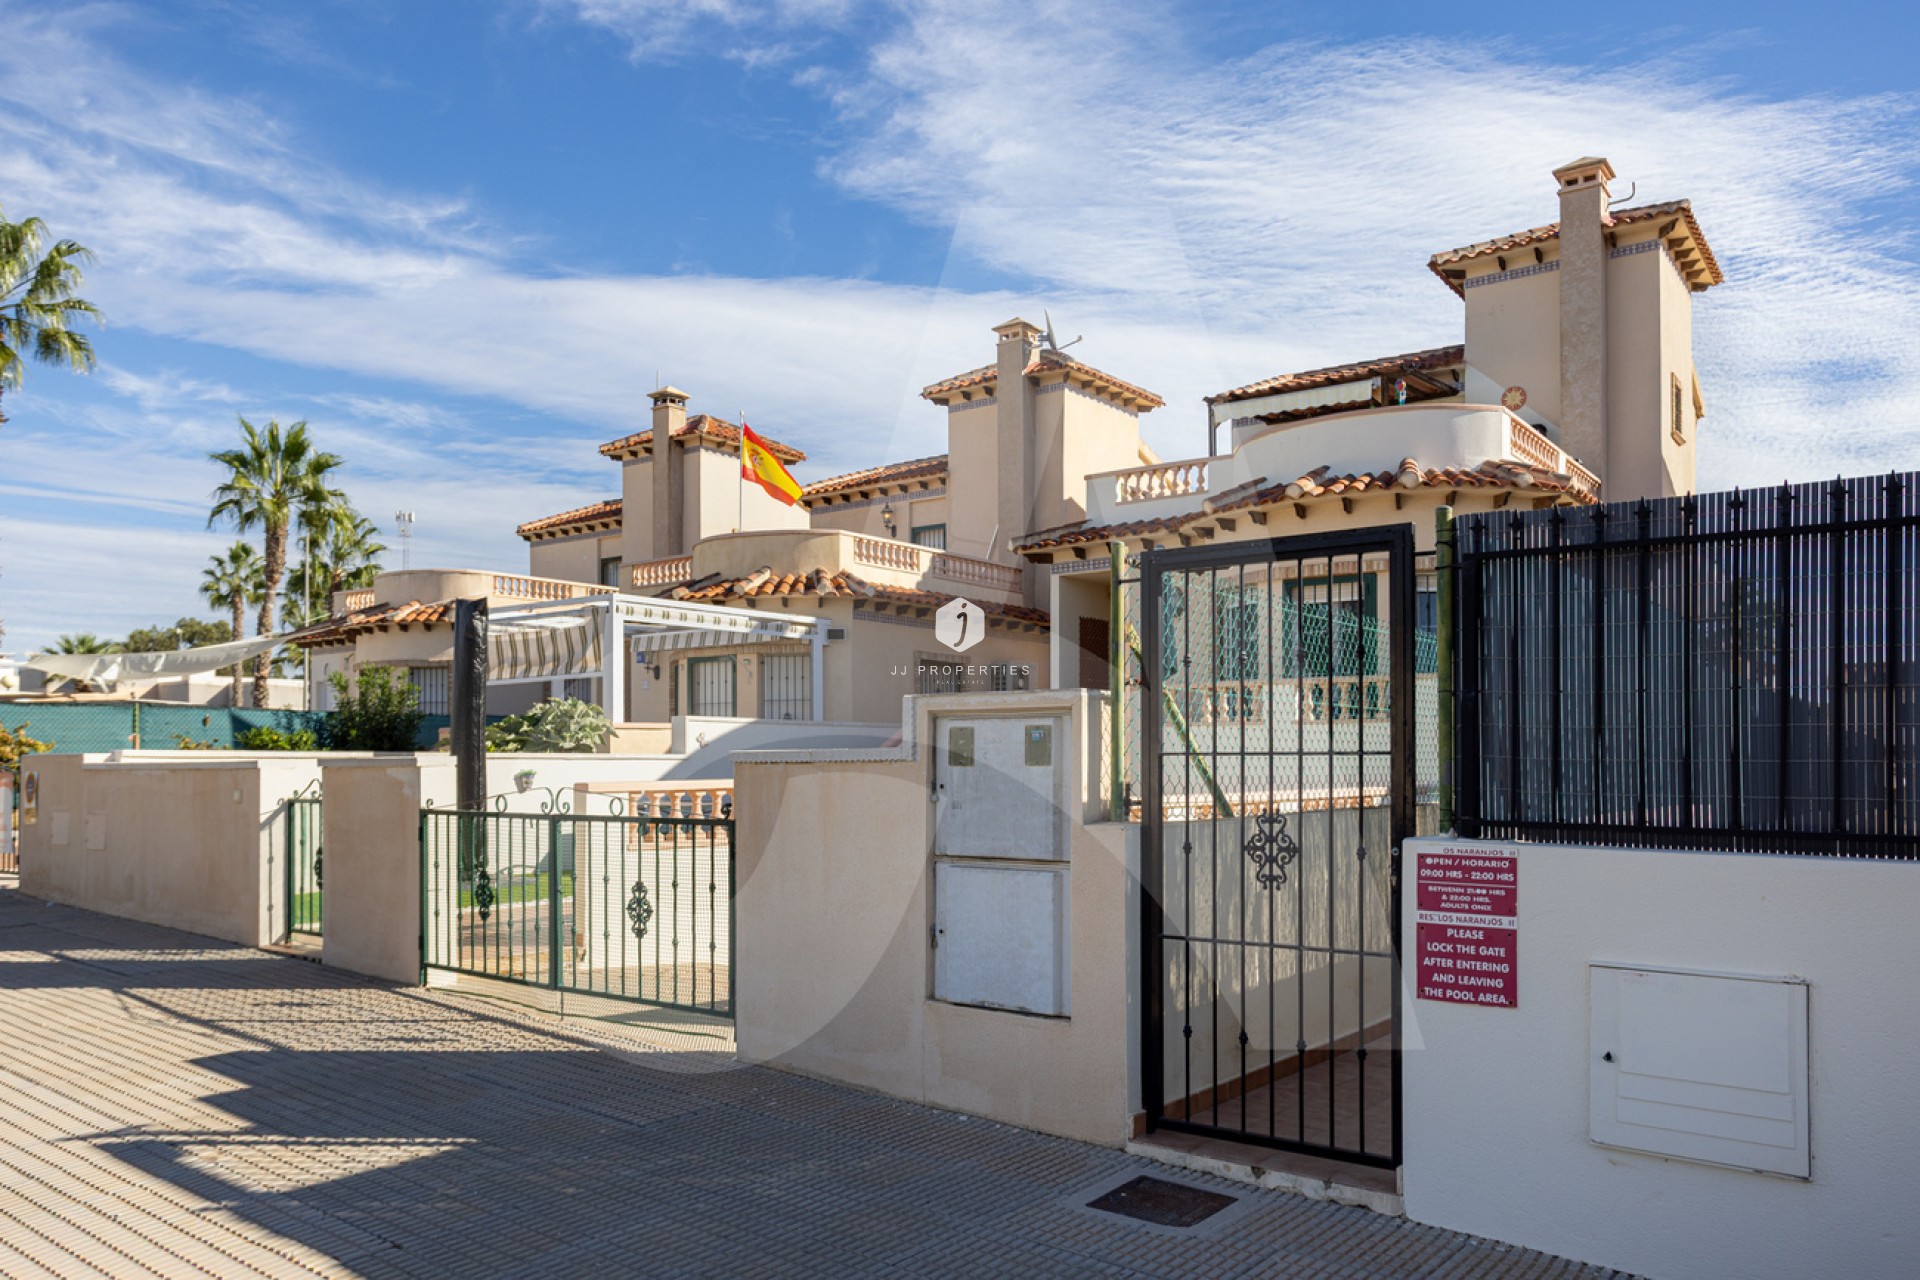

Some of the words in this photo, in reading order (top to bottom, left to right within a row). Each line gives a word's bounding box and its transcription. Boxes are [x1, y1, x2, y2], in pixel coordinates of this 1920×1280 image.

[1457, 848, 1504, 856] NARANJOS
[1425, 857, 1453, 866] OPEN
[1462, 859, 1509, 868] HORARIO
[1420, 869, 1444, 878] 09:00
[1446, 870, 1463, 879] HRS
[1471, 871, 1494, 880] 22:00
[1497, 873, 1515, 881] HRS
[1438, 914, 1454, 923] LOS
[1456, 915, 1503, 926] NARANJOS
[1447, 928, 1484, 940] PLEASE
[1426, 942, 1454, 953] LOCK
[1456, 944, 1476, 955] THE
[1479, 946, 1506, 957] GATE
[1423, 957, 1453, 968] AFTER
[1456, 959, 1510, 973] ENTERING
[1432, 972, 1455, 983] AND
[1458, 975, 1504, 988] LEAVING
[1424, 987, 1443, 998] THE
[1446, 989, 1475, 1001] POOL
[1478, 993, 1509, 1005] AREA.
